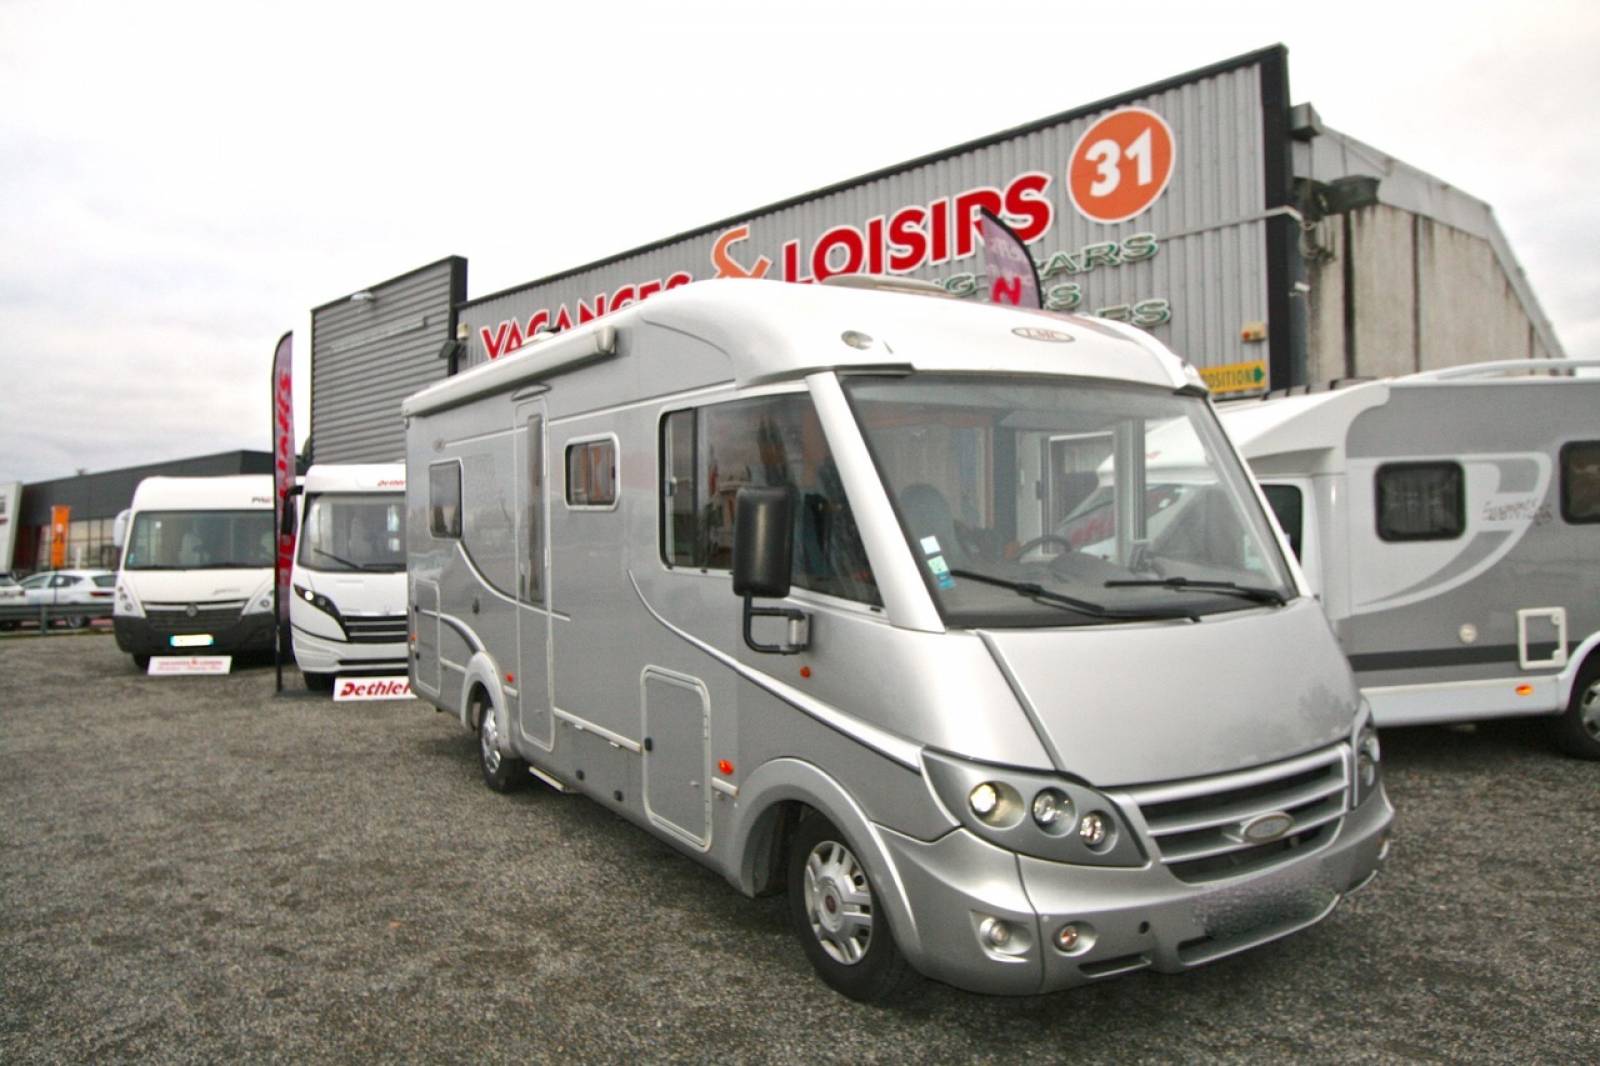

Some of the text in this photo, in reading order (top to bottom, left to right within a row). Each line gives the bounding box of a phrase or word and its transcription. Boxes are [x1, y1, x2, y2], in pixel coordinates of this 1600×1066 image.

[783, 171, 1054, 284] LOISIRS
[1085, 127, 1152, 198] 31
[1037, 232, 1159, 281] ARS
